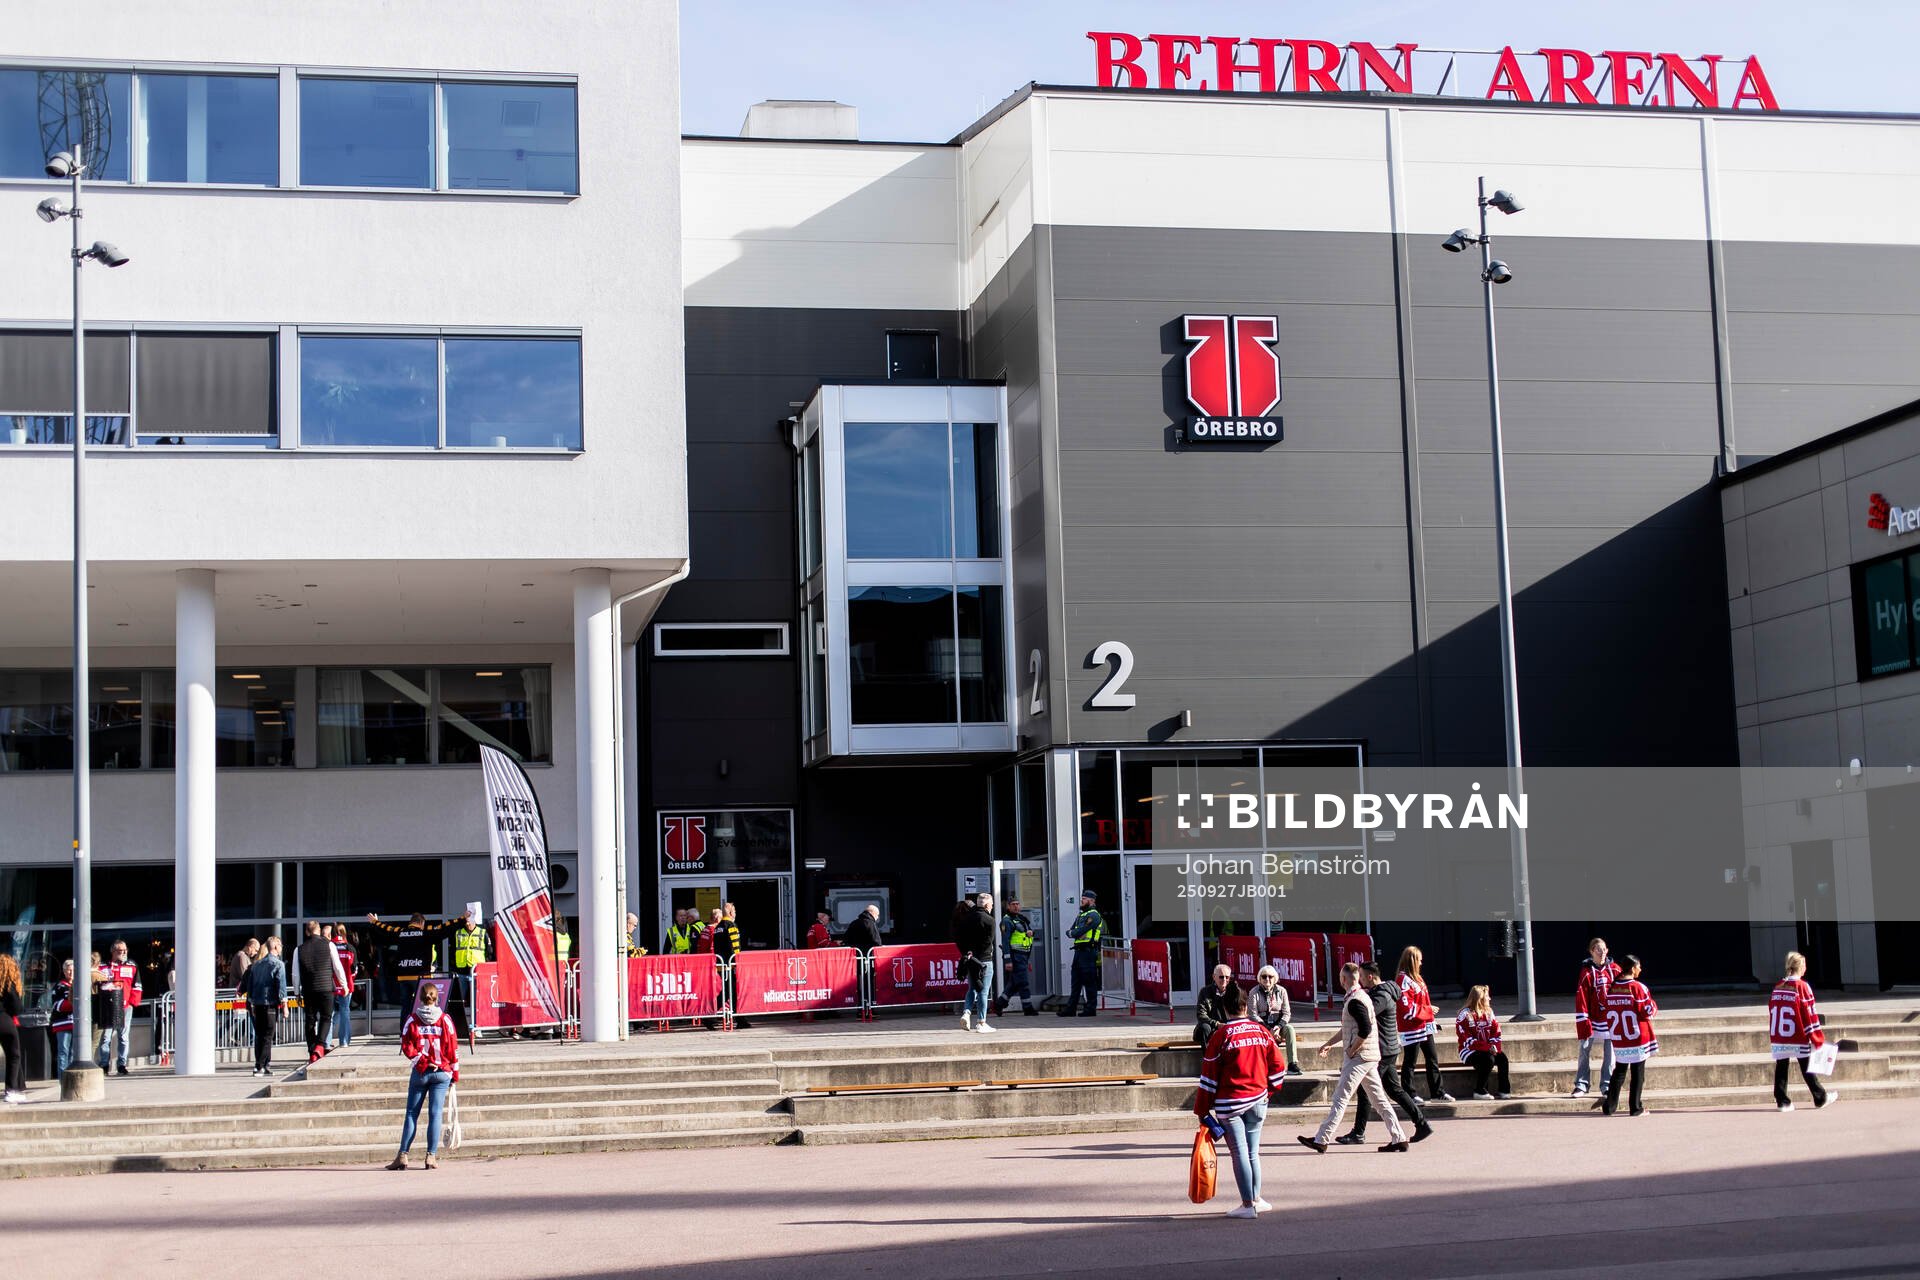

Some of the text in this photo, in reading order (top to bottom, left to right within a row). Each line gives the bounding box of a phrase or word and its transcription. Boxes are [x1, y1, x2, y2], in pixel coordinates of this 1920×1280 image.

[1087, 31, 1781, 111] BEHRN ARENA
[1194, 417, 1278, 437] ÖREBRO
[1029, 648, 1044, 716] 2
[1091, 640, 1136, 707] 2
[667, 860, 705, 870] ÖREBRO
[925, 979, 945, 988] ROAD
[641, 993, 699, 1003] ROAD RENTAL
[763, 989, 796, 1004] NÄRKES
[1606, 1010, 1640, 1041] 20
[1770, 1006, 1796, 1037] 16
